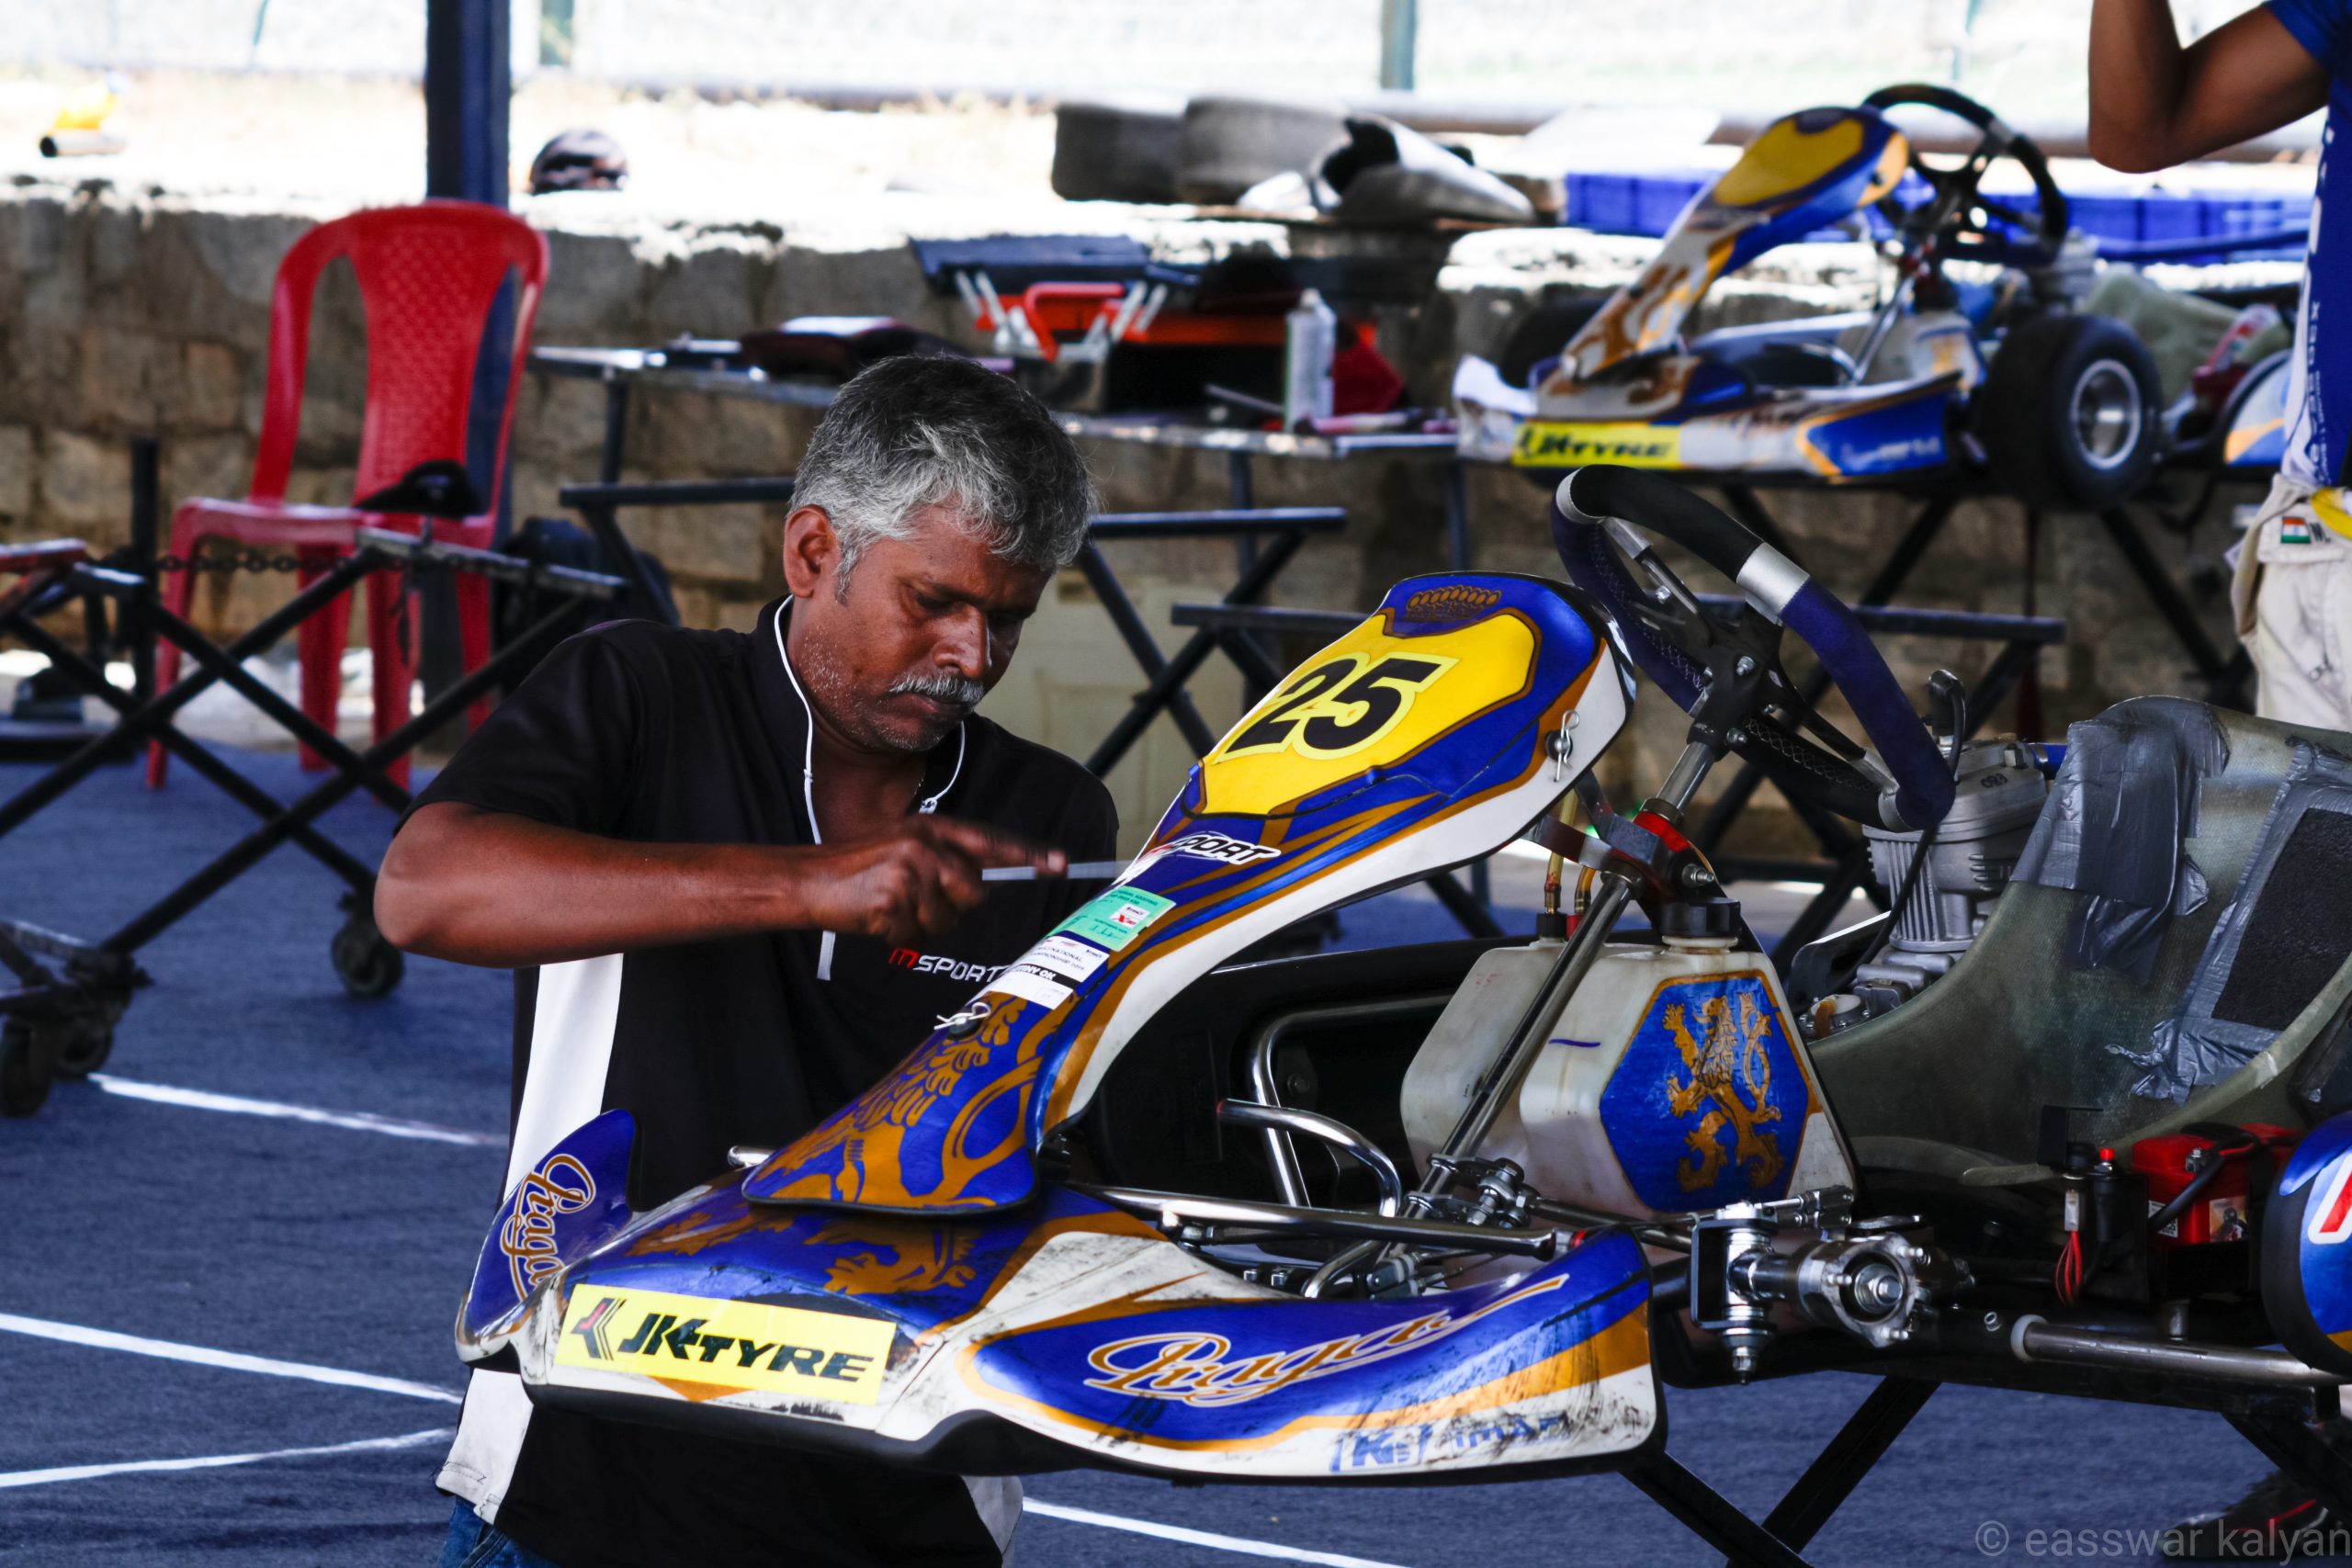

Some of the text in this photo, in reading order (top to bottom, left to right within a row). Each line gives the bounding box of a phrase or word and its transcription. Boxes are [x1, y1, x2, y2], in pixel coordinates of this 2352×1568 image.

[1222, 656, 1448, 753] 25
[1039, 969, 1057, 981] OK
[1084, 1278, 1567, 1408] Praga
